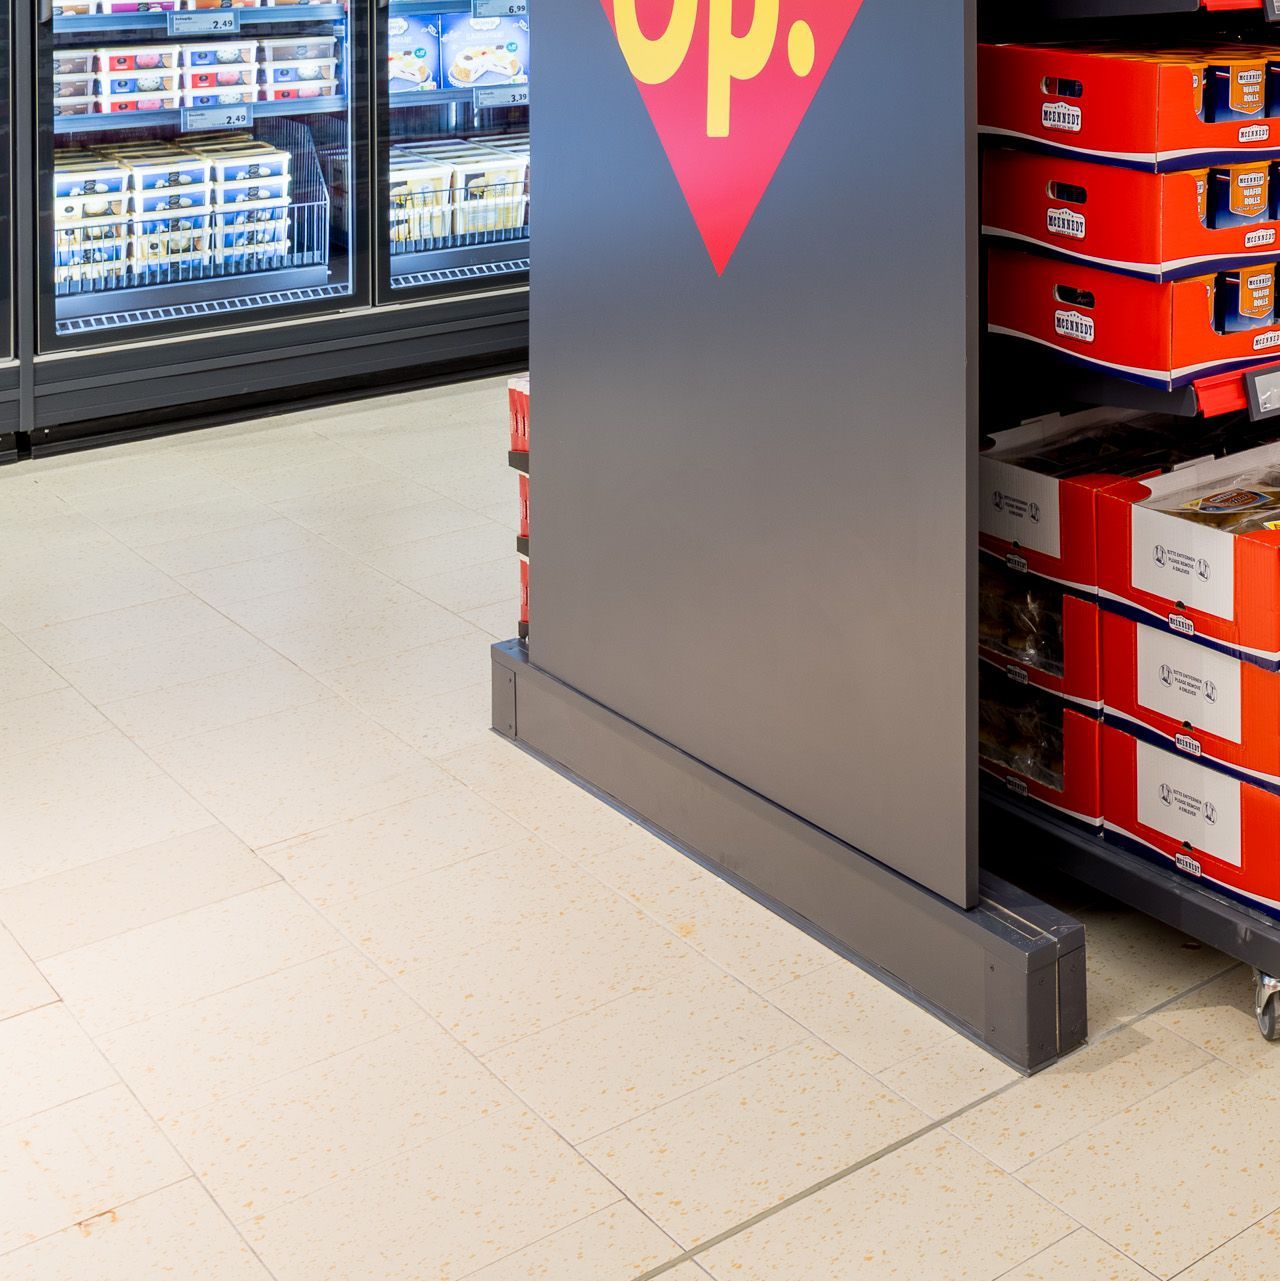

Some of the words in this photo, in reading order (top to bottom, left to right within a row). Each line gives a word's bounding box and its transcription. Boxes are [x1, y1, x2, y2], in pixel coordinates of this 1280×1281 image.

[508, 4, 526, 14] 6.99
[212, 19, 233, 31] 2.49
[1243, 84, 1259, 93] WAFER
[509, 93, 527, 104] 3.39
[1244, 94, 1259, 102] ROLLS
[226, 114, 246, 126] 2.49
[1043, 109, 1079, 127] MCENNEDY
[1240, 128, 1268, 139] MCENNEDY
[1048, 215, 1084, 234] MCENNEDY
[1252, 289, 1269, 297] WAFER
[1056, 317, 1093, 338] MCENNEDY
